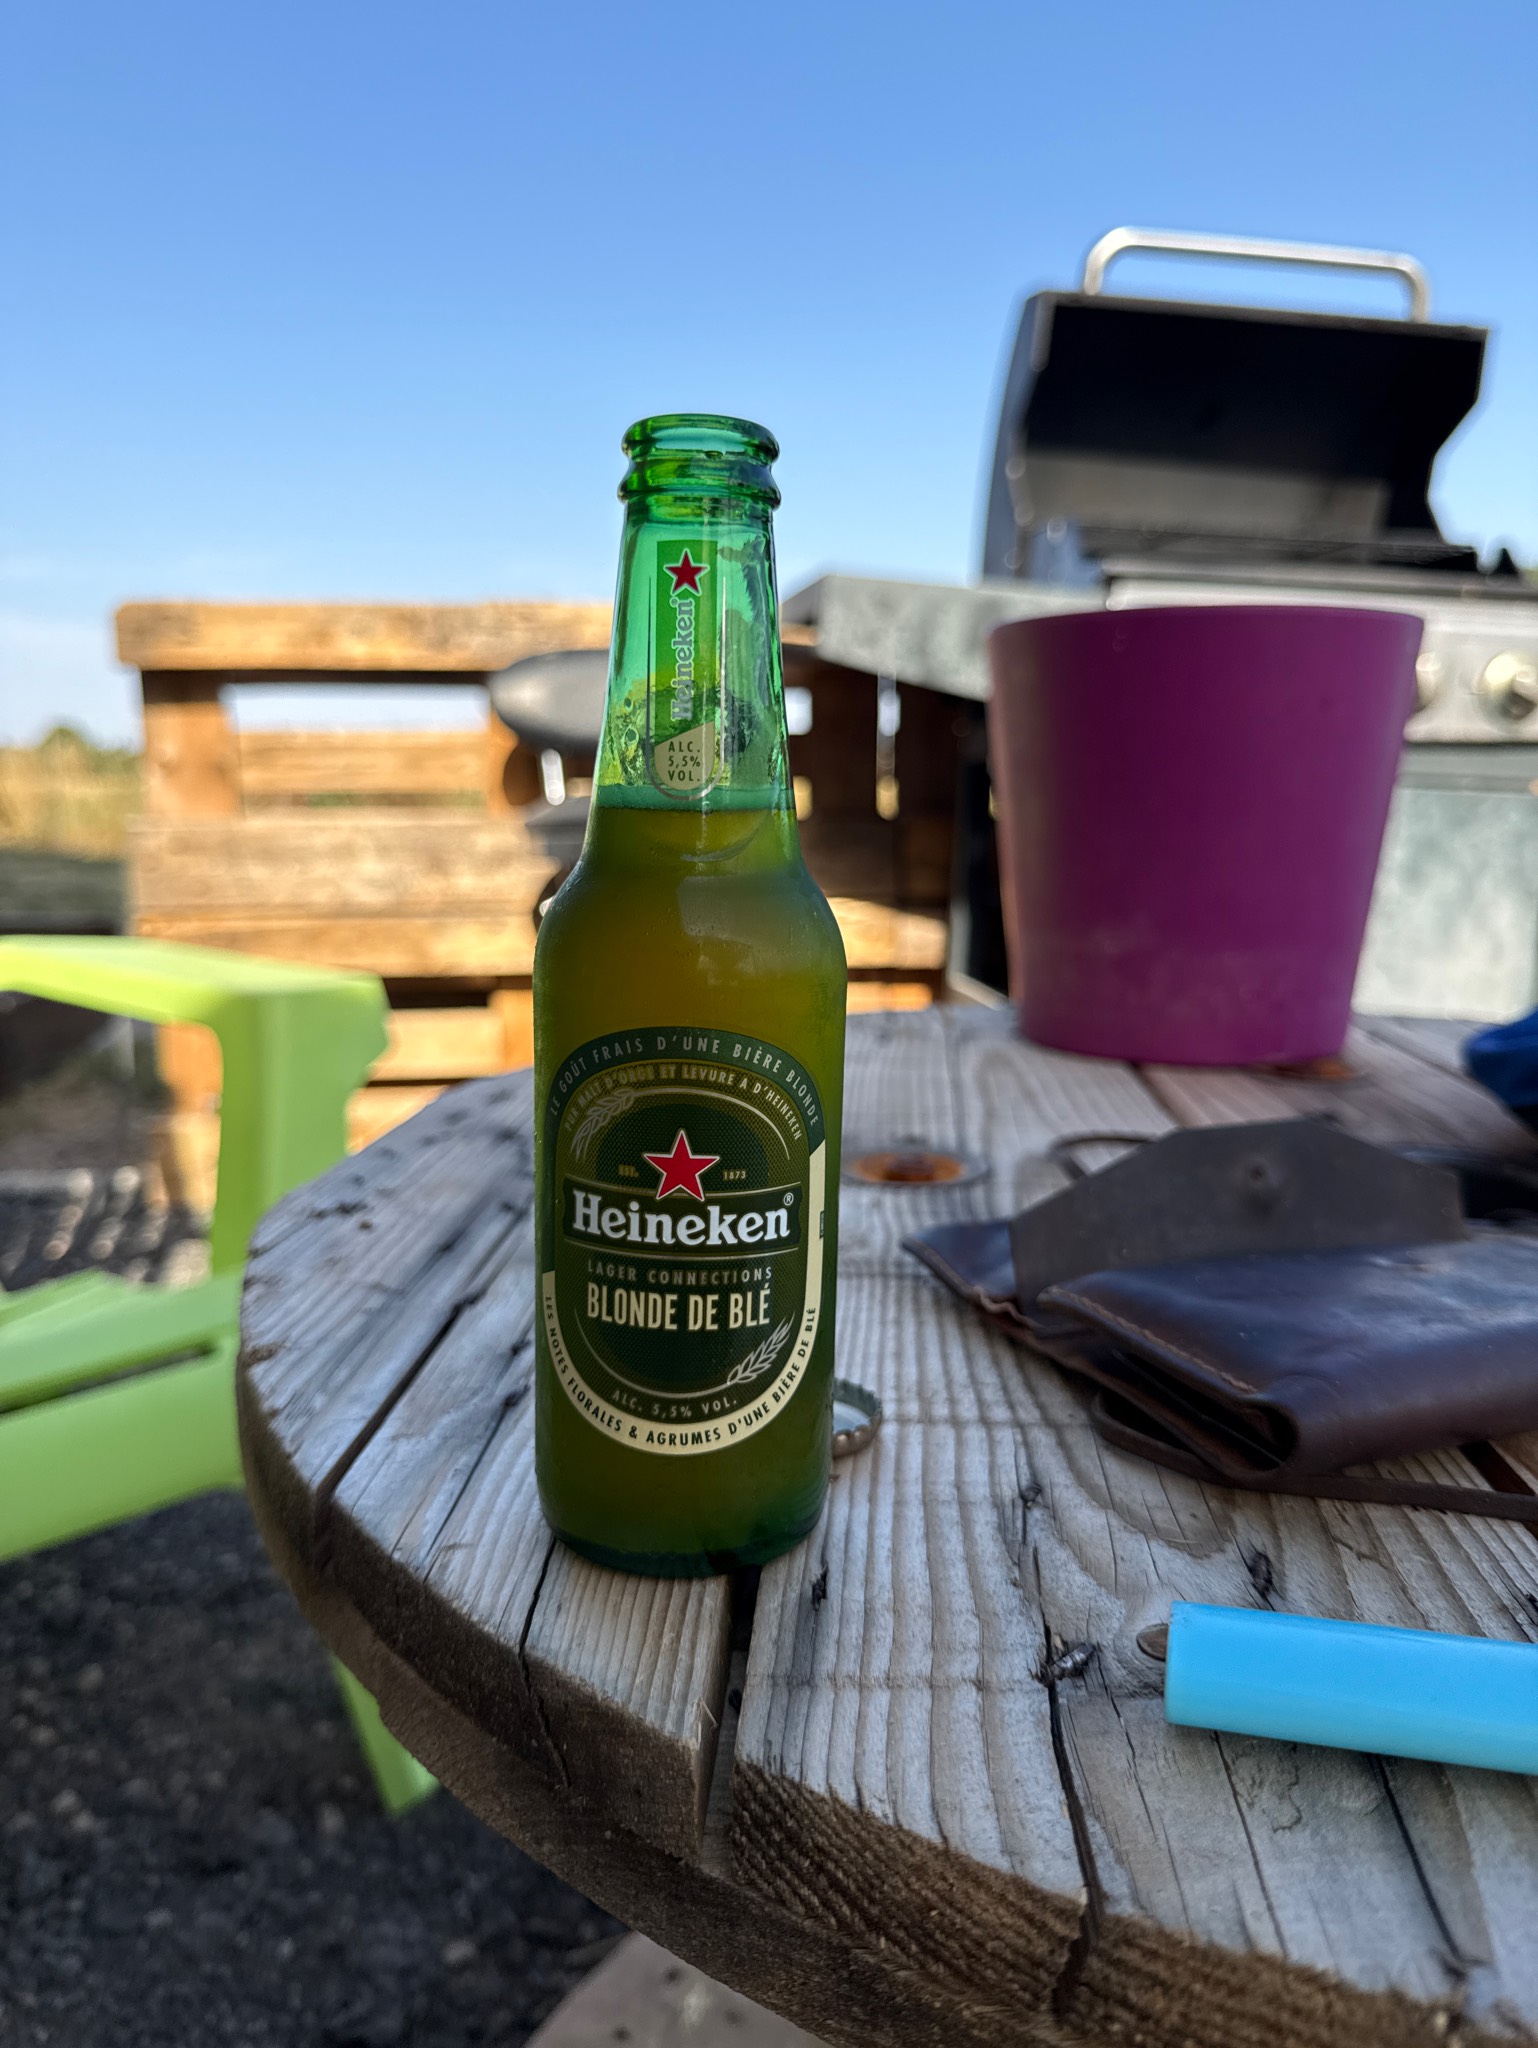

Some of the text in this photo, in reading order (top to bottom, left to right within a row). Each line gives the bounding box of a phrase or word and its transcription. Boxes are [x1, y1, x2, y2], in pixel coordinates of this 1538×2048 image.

[671, 598, 695, 721] Heineken
[668, 741, 700, 752] ALC.
[668, 756, 701, 769] 5,5%
[668, 770, 700, 781] VOL.
[550, 1036, 819, 1126] LE GOÛT FRAIS D'UNE BIÈRE BLONDE
[565, 1108, 579, 1132] PUR
[579, 1081, 602, 1107] MALT
[660, 1064, 677, 1080] ET
[681, 1065, 735, 1085] LEVURE
[753, 1082, 803, 1140] D'HEINEKEN
[724, 1171, 746, 1180] 1873
[573, 1188, 790, 1246] Heineken
[588, 1260, 772, 1286] LAGER CONNECTIONS
[588, 1282, 771, 1331] BLONDE DE BLÉ
[546, 1296, 816, 1446] LES NOTES FLORALES & AGRUMES D'UNE BIÈRE DE BLÉ
[612, 1390, 737, 1419] ALC. 5,5% VOL.
